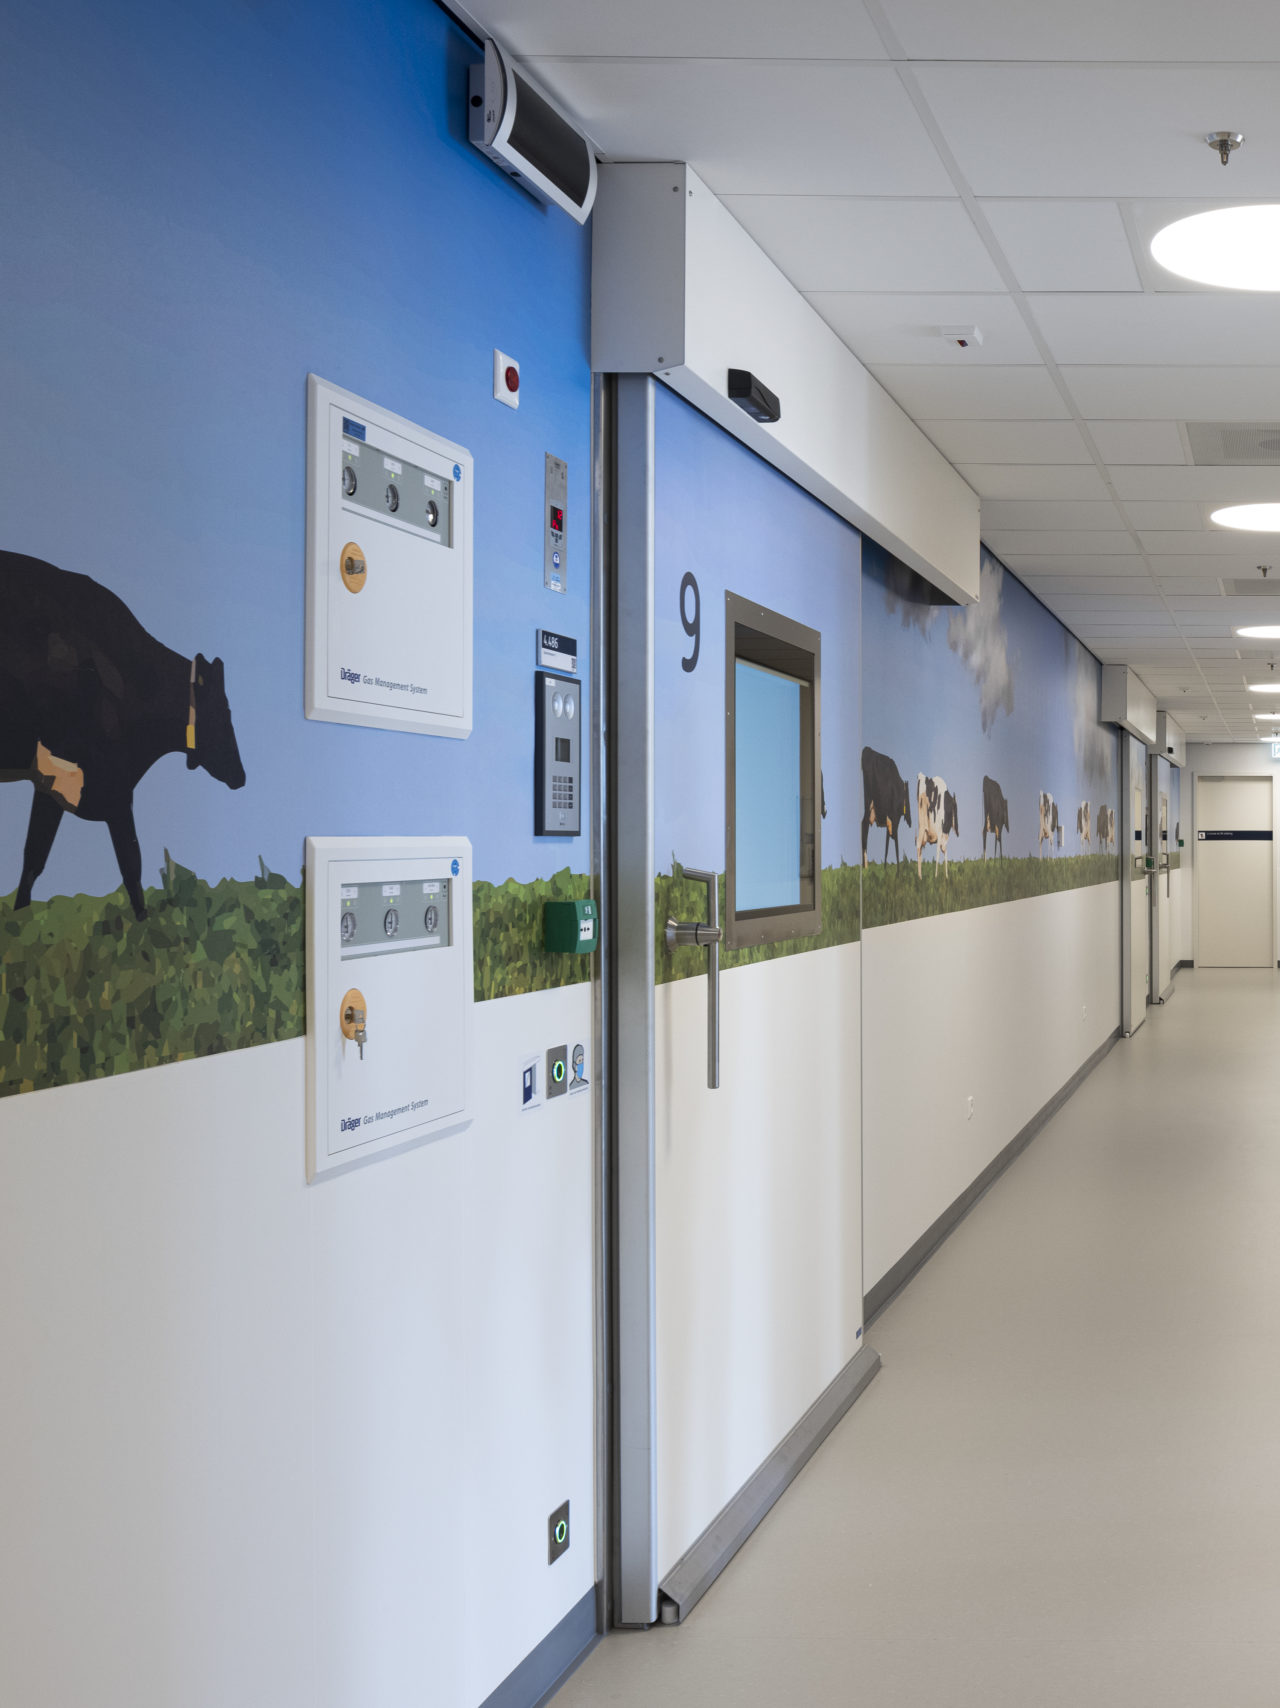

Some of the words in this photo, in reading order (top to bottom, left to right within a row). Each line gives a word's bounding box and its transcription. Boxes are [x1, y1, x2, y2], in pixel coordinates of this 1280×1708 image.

[680, 571, 700, 672] 9
[340, 667, 361, 684] Dräger
[363, 675, 374, 685] Gas
[375, 677, 410, 691] Management
[410, 683, 428, 695] System
[340, 1117, 361, 1132] Dräger
[363, 1115, 374, 1124] Gas
[375, 1104, 410, 1121] Management
[411, 1099, 429, 1111] System
